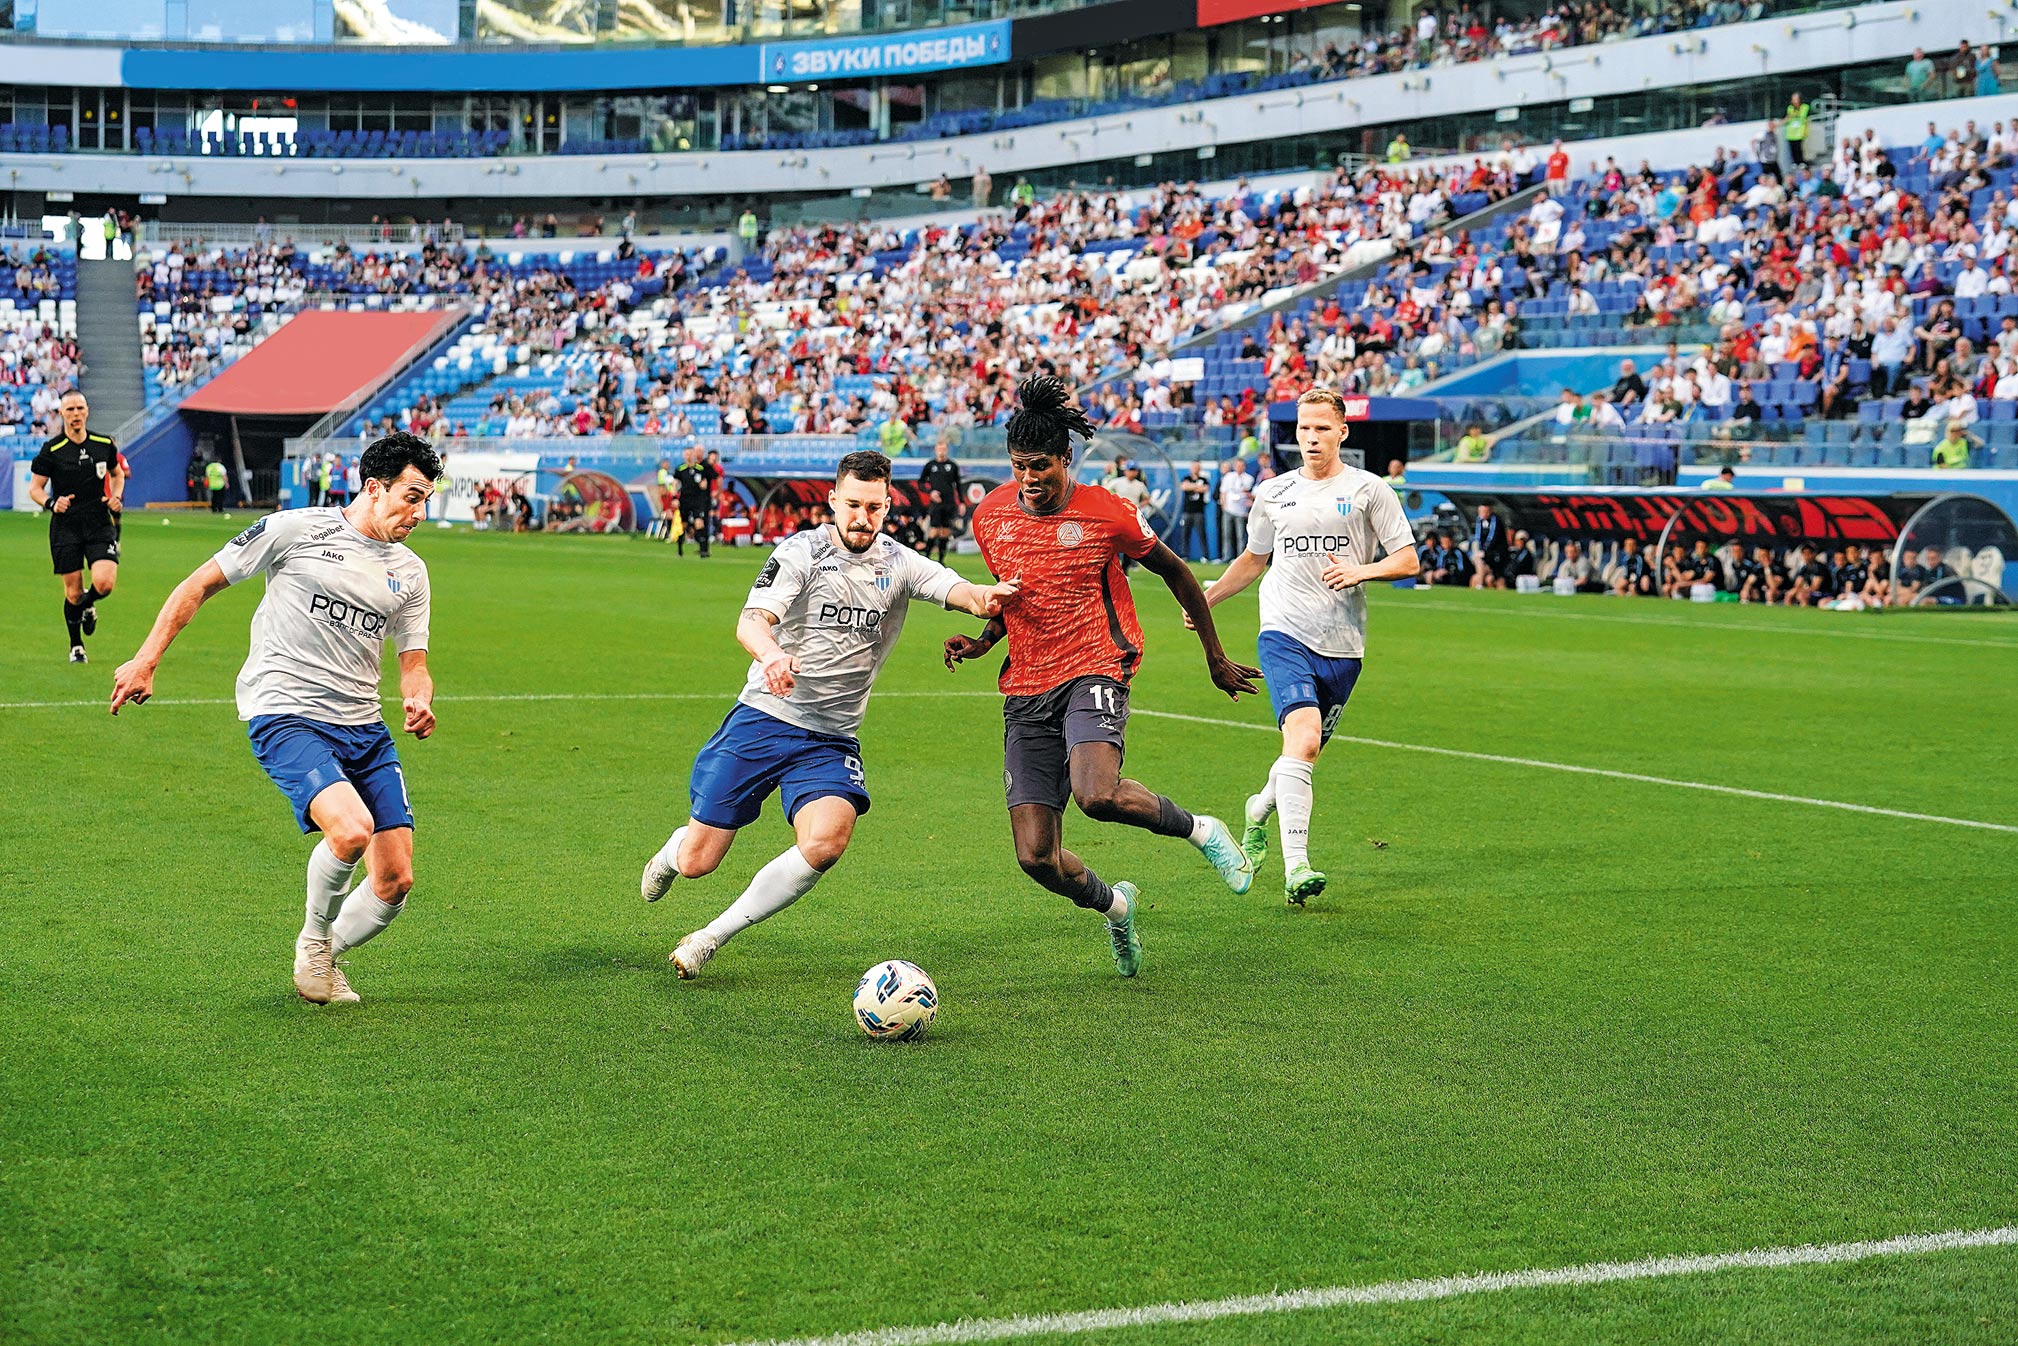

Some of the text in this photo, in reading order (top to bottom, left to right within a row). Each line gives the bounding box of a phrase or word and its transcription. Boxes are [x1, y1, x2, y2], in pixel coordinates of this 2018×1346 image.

[792, 34, 985, 74] ЗВУКИ ПОБЕДЫ
[1280, 501, 1297, 509] JAKO
[310, 524, 345, 541] legalbet
[321, 549, 345, 562] JAKO
[1284, 536, 1350, 553] РОТОР
[310, 593, 387, 634] РОТОР
[1089, 684, 1116, 716] 11
[844, 754, 864, 781] 9
